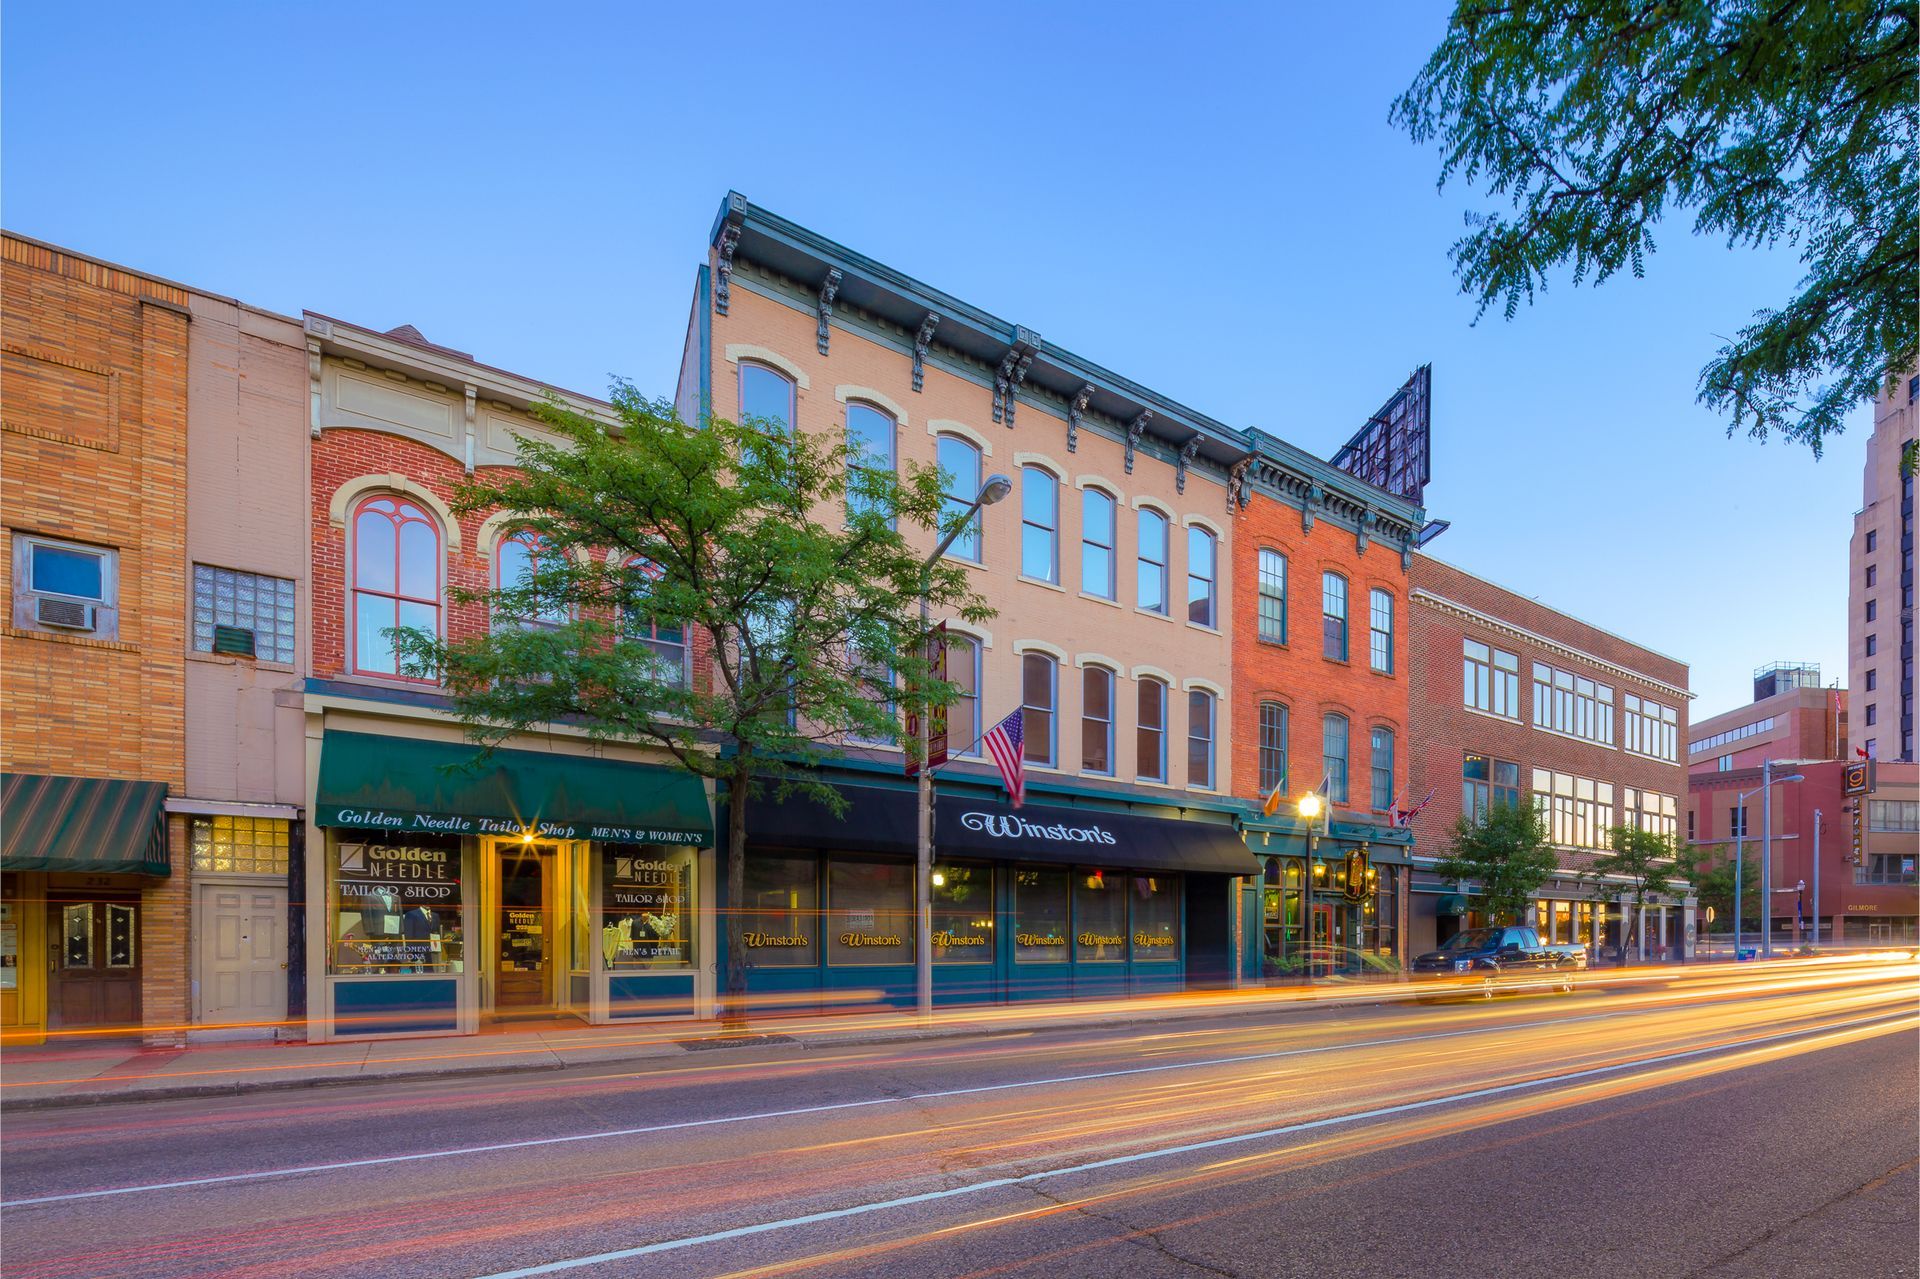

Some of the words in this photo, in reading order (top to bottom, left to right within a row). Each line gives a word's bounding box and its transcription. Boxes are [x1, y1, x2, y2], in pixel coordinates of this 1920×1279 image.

[338, 809, 403, 826] Golden
[412, 814, 471, 830] Needle
[479, 818, 530, 833] Tailor
[538, 822, 576, 838] Shop
[961, 812, 1116, 845] Winston's
[592, 827, 630, 839] MEN'S
[635, 830, 645, 839] &
[649, 831, 702, 842] WOMEN'S
[369, 845, 447, 862] Golden
[371, 862, 446, 879] NEEDLE
[634, 860, 685, 871] Golden
[635, 871, 684, 884] NEEDLE
[340, 884, 399, 897] TAILOR
[405, 886, 451, 898] SHOP
[616, 894, 652, 903] TAILOR
[656, 894, 685, 904] SHOP
[743, 932, 808, 947] Winston's
[840, 932, 902, 947] Winston's
[931, 932, 985, 947] Winston's
[1017, 933, 1065, 946] Winston's
[1078, 933, 1122, 946] Winston's
[1134, 933, 1174, 946] Winston's
[367, 953, 425, 961] ALTERATIONS
[622, 948, 648, 956] MEN'S
